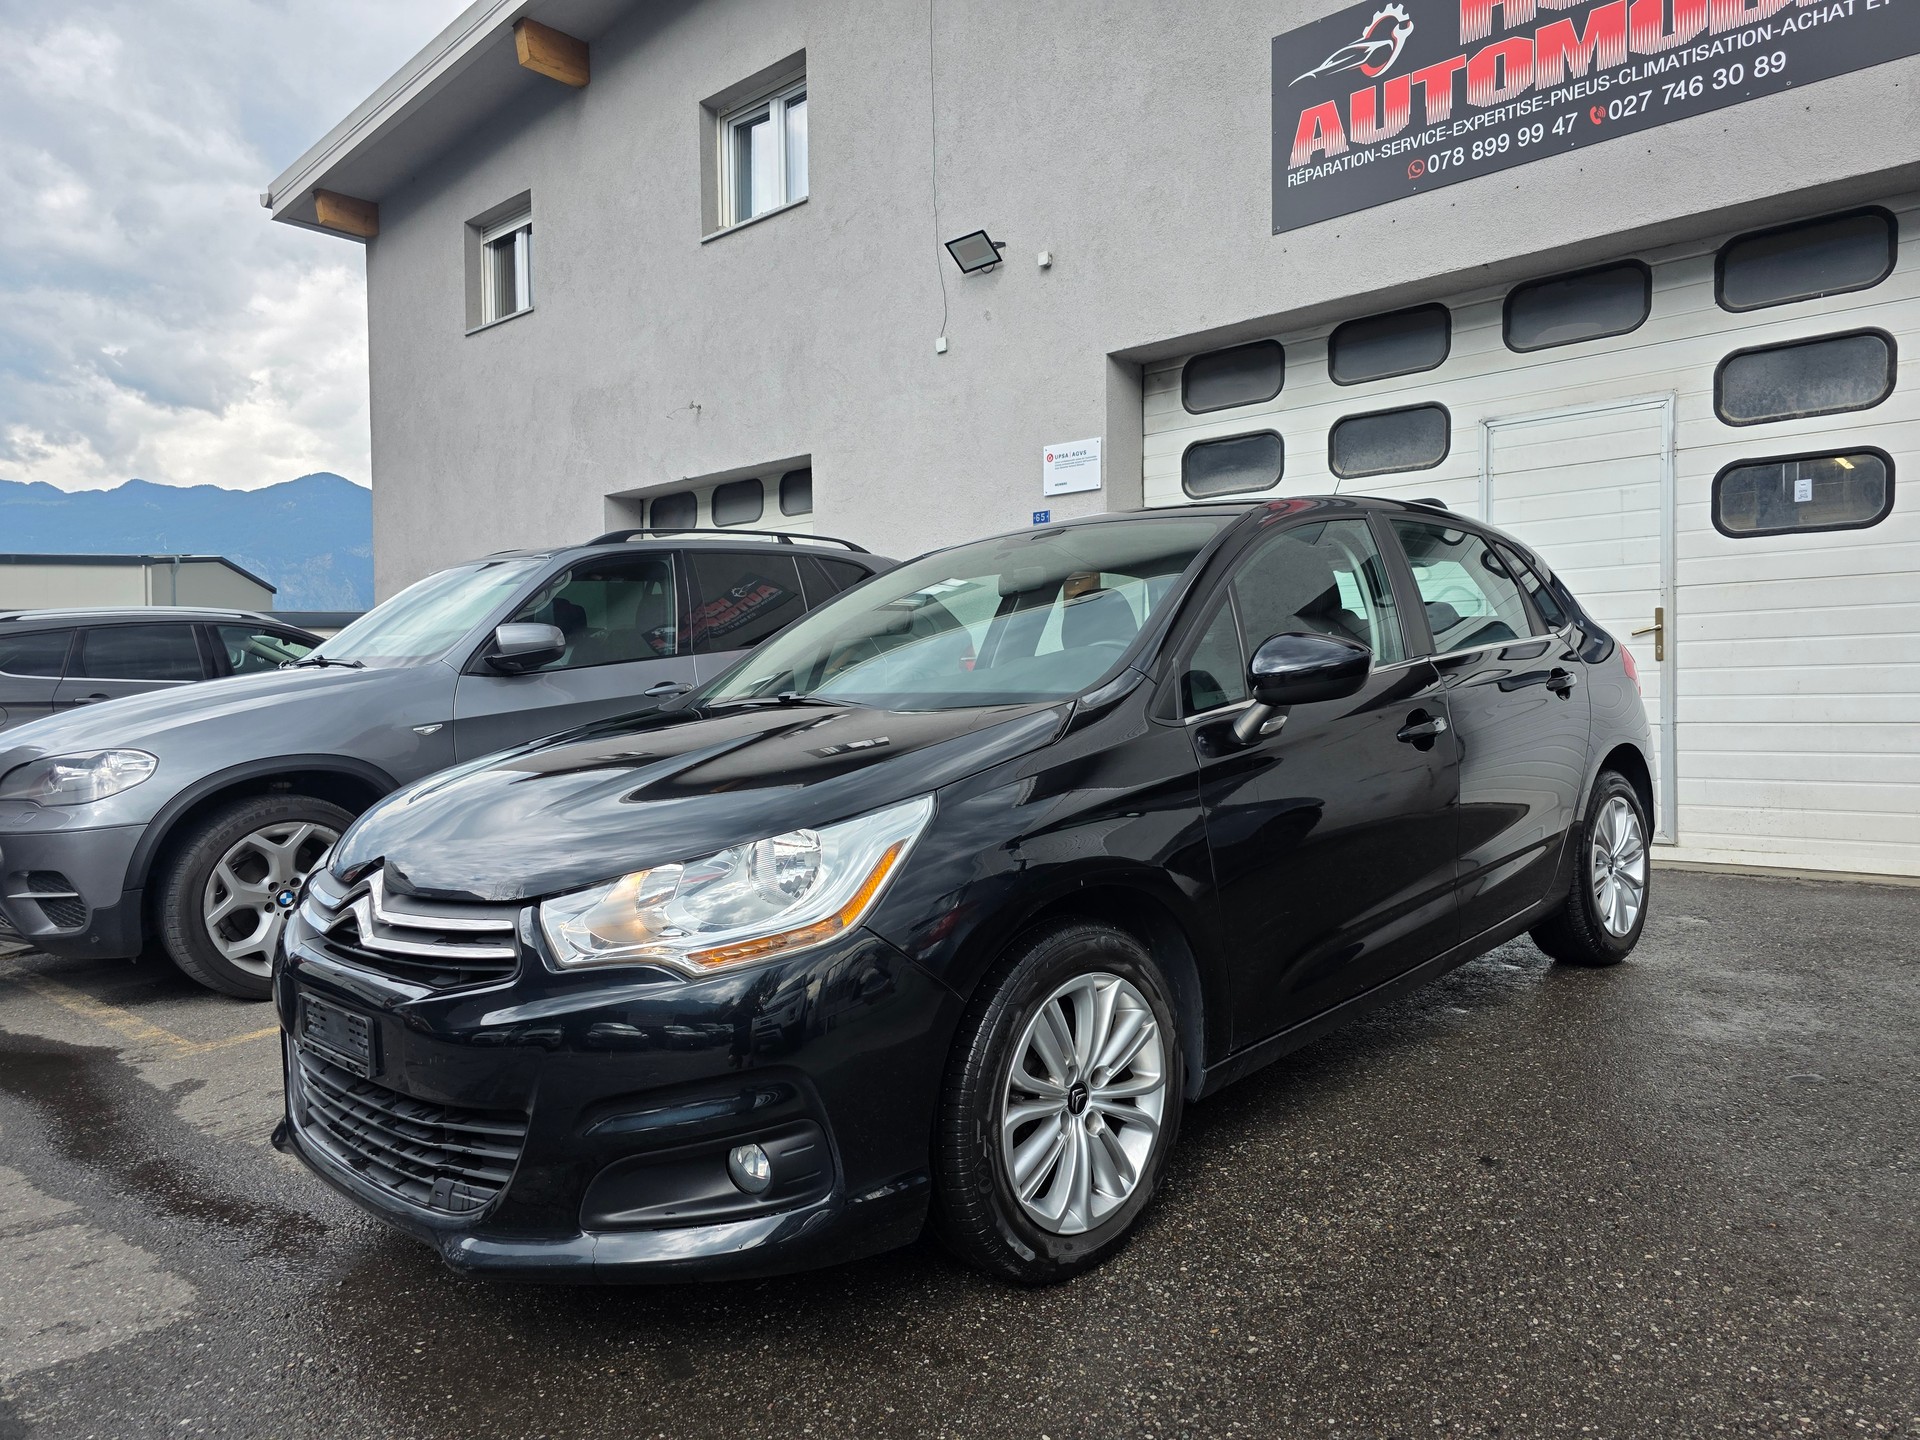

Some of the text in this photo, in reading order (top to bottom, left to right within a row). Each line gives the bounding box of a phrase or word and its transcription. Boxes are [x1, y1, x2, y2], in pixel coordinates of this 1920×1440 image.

[1427, 51, 1786, 173] 078 899 99 47 027 746 30 89
[1035, 512, 1046, 522] 65
